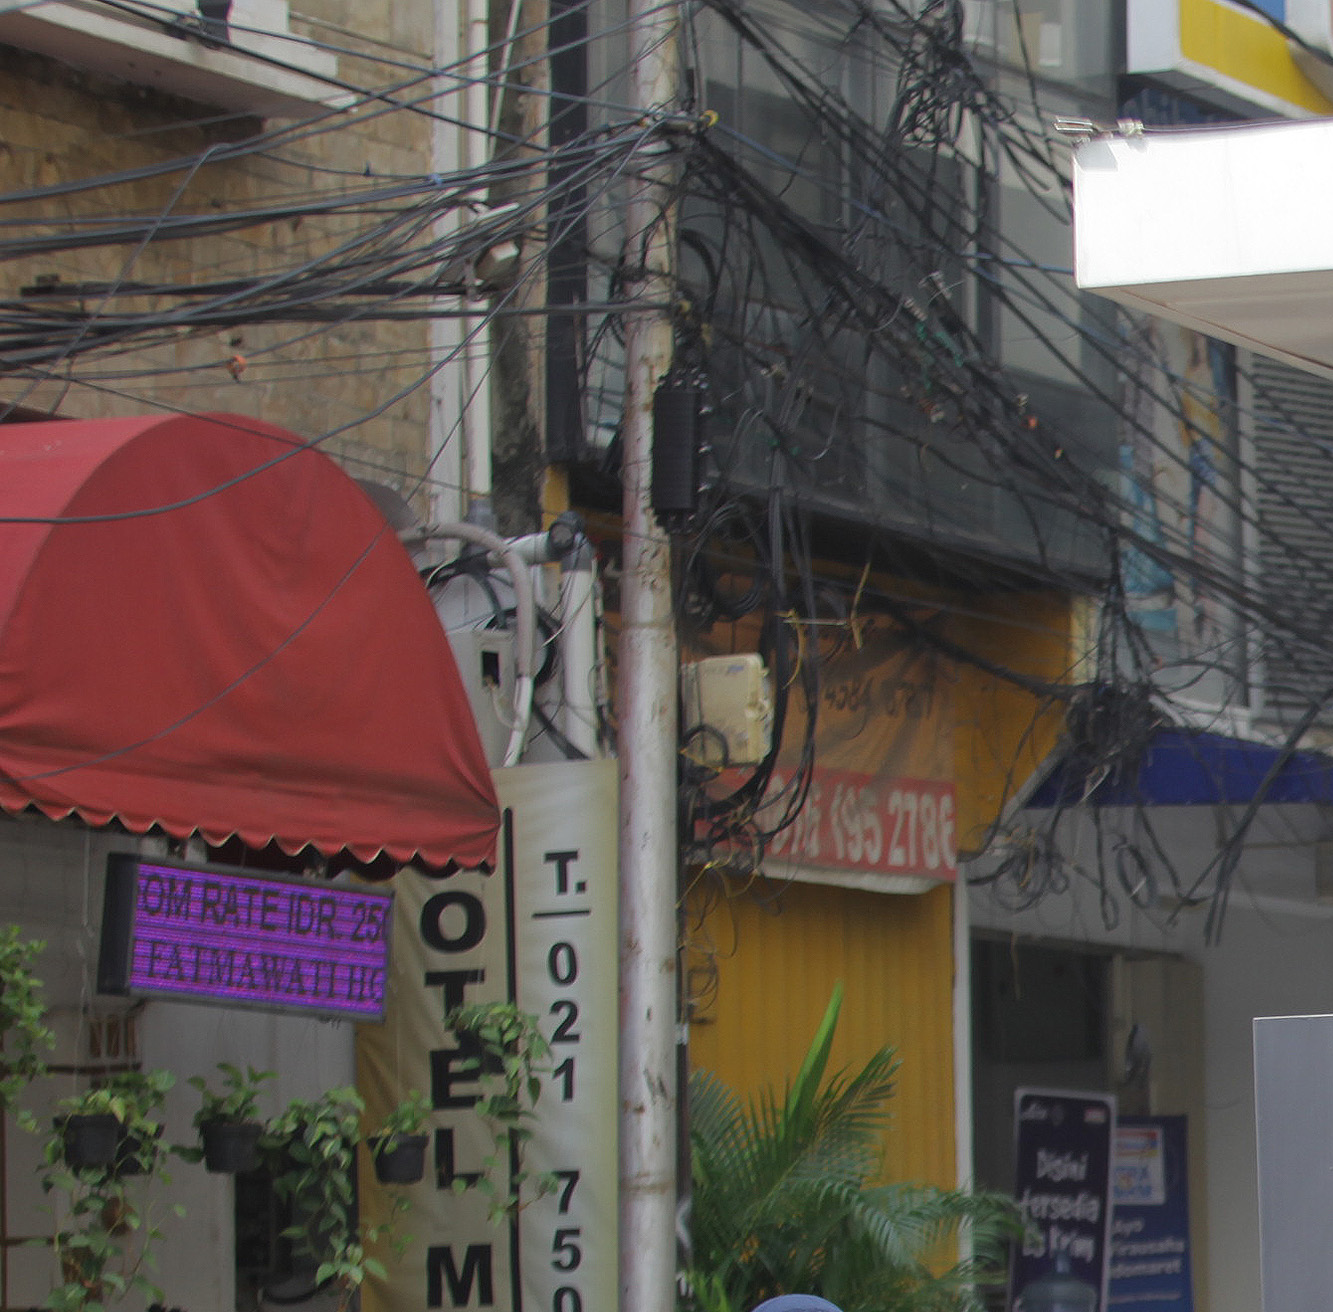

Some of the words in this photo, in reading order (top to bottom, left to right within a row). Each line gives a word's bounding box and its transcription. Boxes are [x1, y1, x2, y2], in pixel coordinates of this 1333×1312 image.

[544, 850, 588, 895] T.
[201, 880, 281, 931] RATE
[149, 940, 336, 998] FATMAWATI
